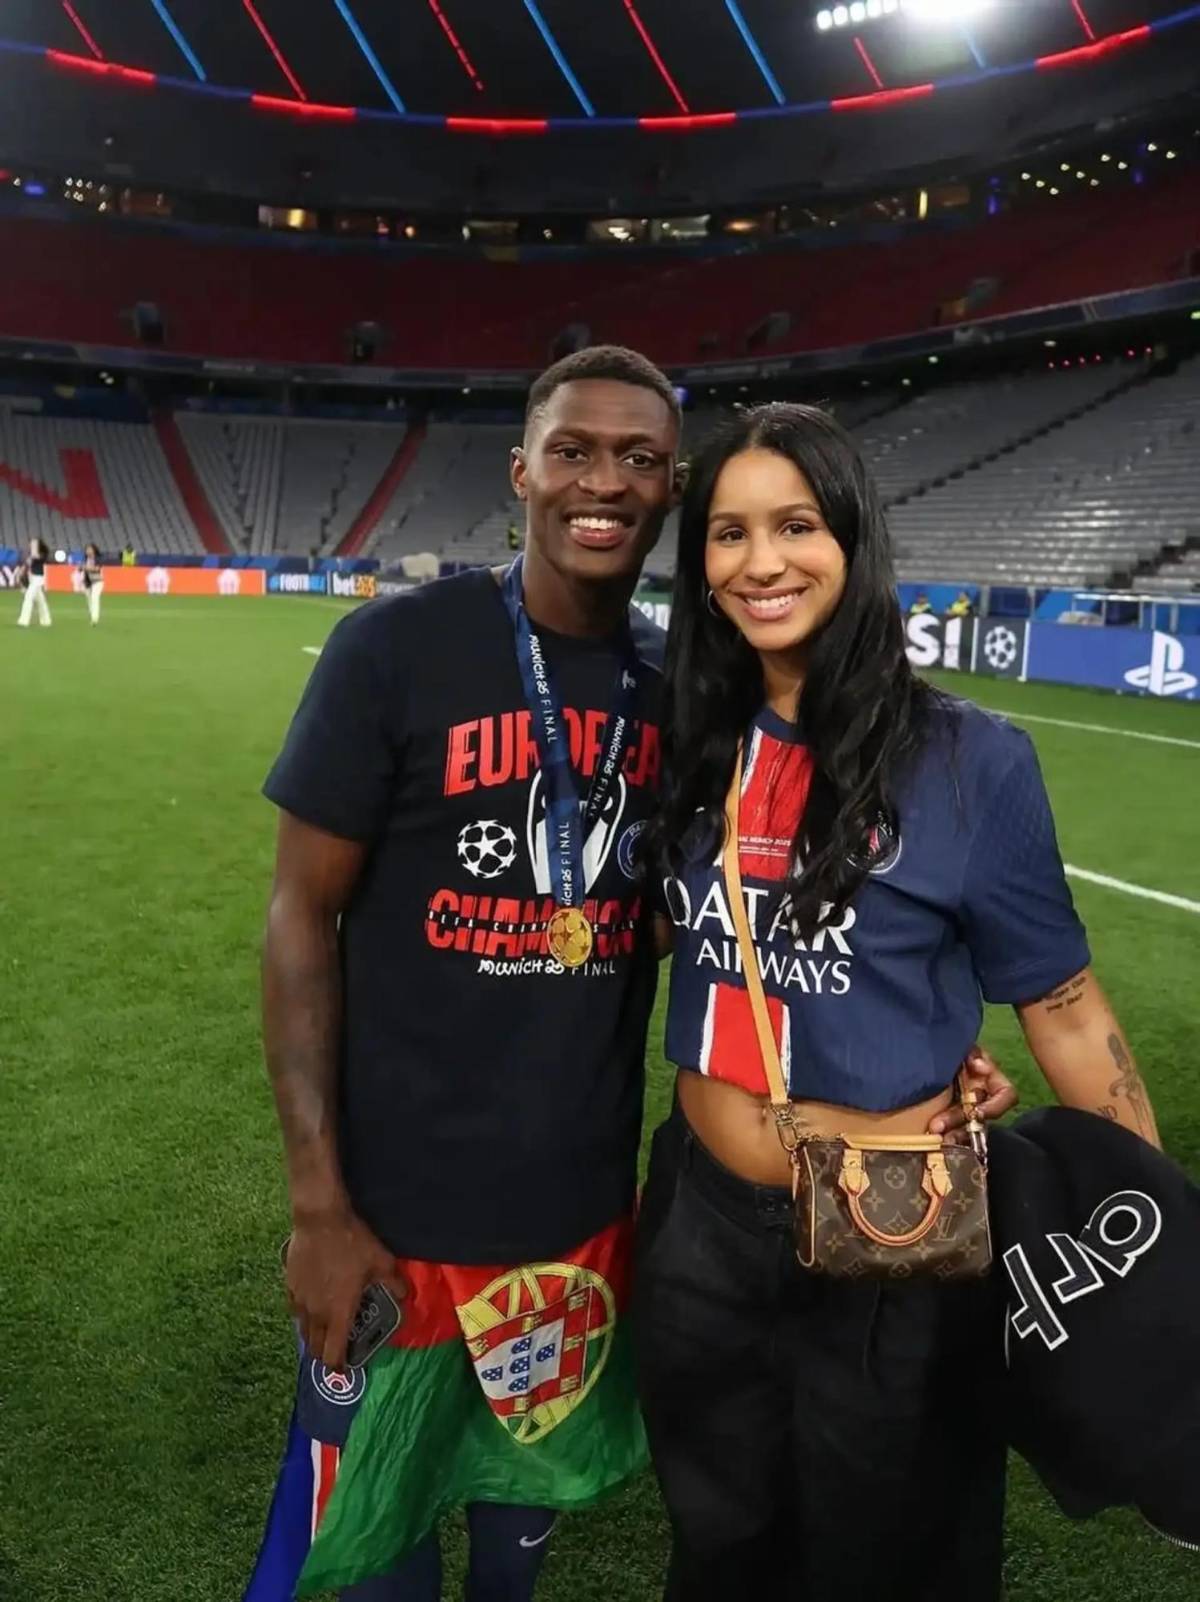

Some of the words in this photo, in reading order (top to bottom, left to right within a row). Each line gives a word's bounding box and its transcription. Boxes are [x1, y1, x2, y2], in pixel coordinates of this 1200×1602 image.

[541, 699, 558, 743] FINAL
[558, 821, 571, 865] FINAL
[663, 875, 857, 956] QATAR
